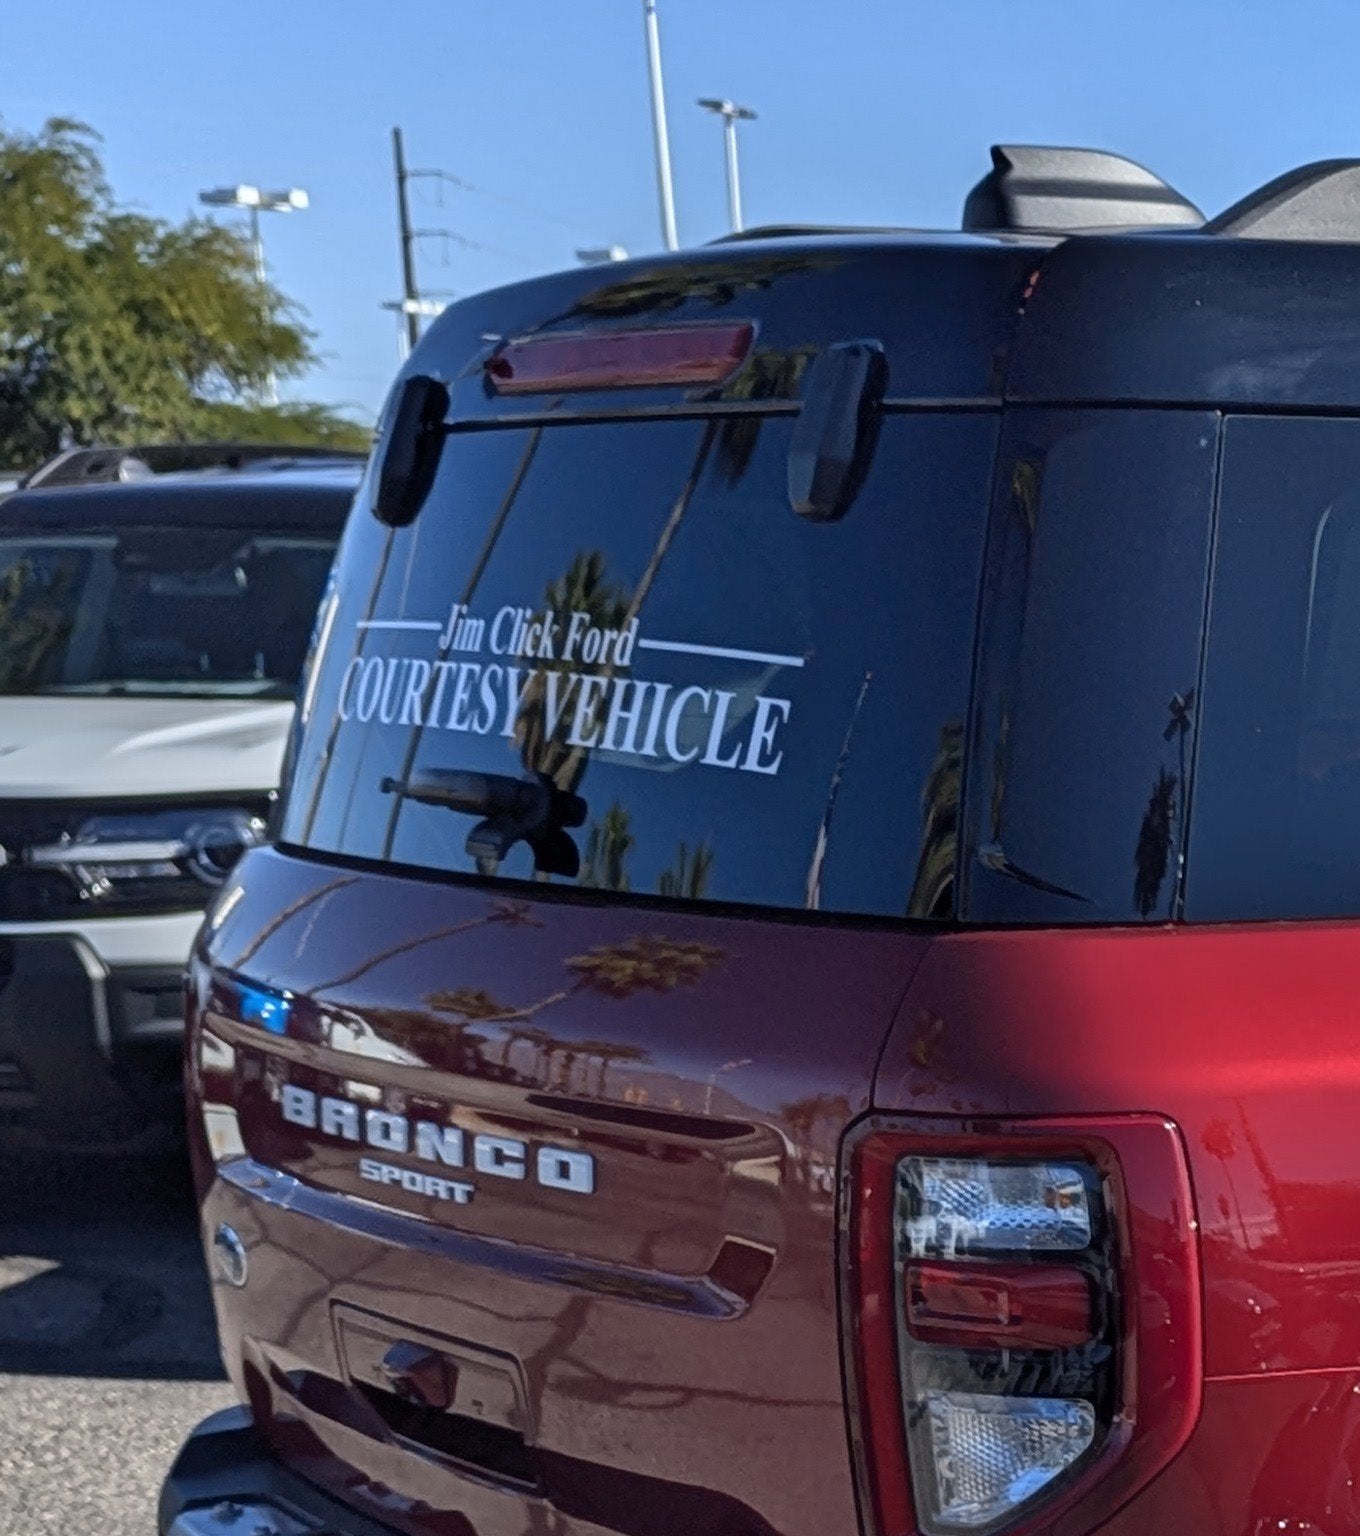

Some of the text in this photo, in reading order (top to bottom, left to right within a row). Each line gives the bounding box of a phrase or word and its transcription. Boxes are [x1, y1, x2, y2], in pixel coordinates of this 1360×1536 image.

[438, 603, 640, 667] Jim Click Ford
[338, 655, 792, 775] COURTESY VEHICLE
[281, 1083, 595, 1195] BRONCO
[359, 1157, 475, 1205] SPORT
